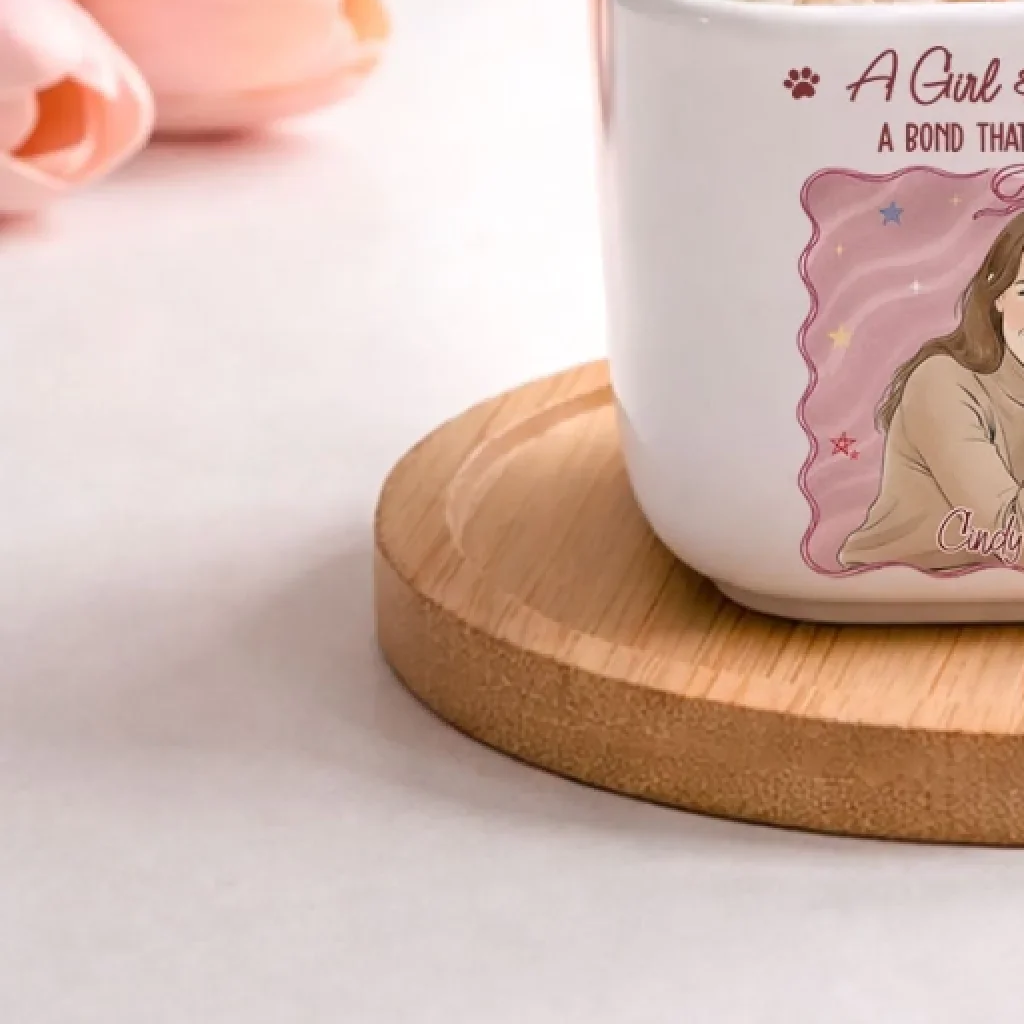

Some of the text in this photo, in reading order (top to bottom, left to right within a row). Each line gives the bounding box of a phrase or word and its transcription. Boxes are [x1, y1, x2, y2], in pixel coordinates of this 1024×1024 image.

[846, 49, 898, 102] A
[909, 45, 1002, 105] Girl
[877, 122, 894, 153] A
[905, 122, 964, 153] BOND
[937, 507, 1024, 564] Cindy
